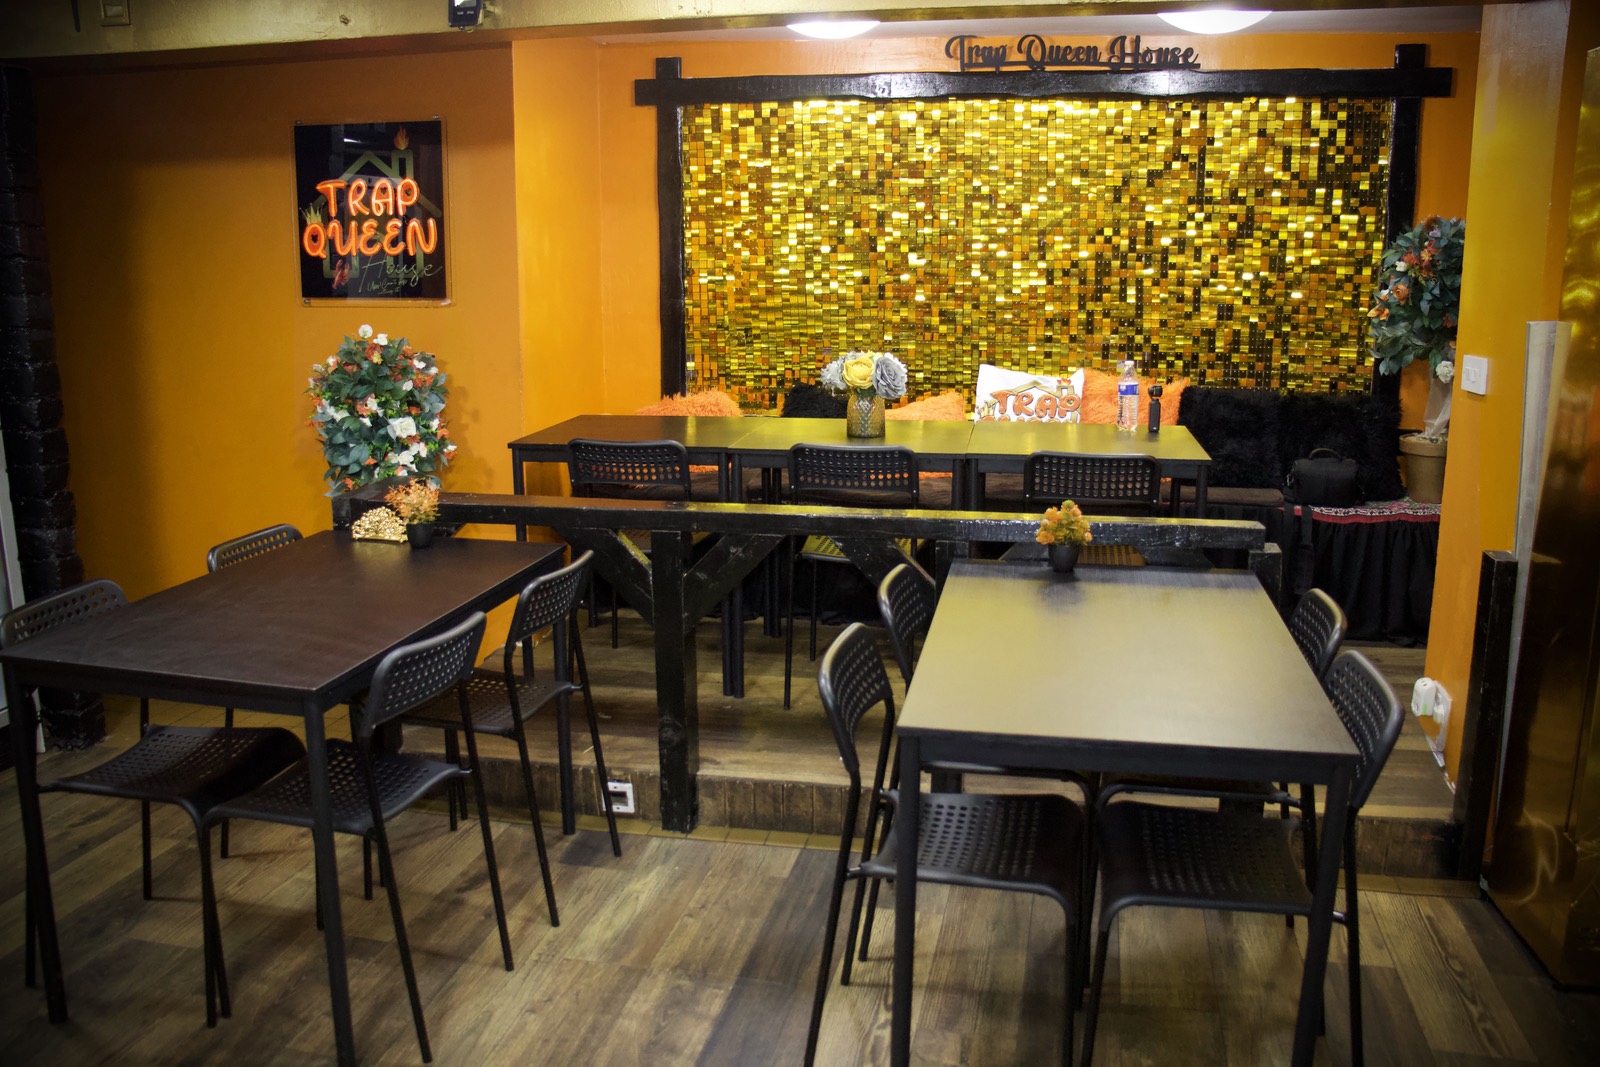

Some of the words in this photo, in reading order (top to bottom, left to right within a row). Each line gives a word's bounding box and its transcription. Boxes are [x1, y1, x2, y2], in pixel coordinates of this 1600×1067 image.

[945, 35, 1007, 74] Trap
[1018, 34, 1102, 72] Queen
[1108, 35, 1200, 72] House
[316, 178, 420, 217] TRAP
[303, 217, 438, 258] QUEEN
[359, 253, 443, 292] House
[990, 390, 1080, 418] TRAP
